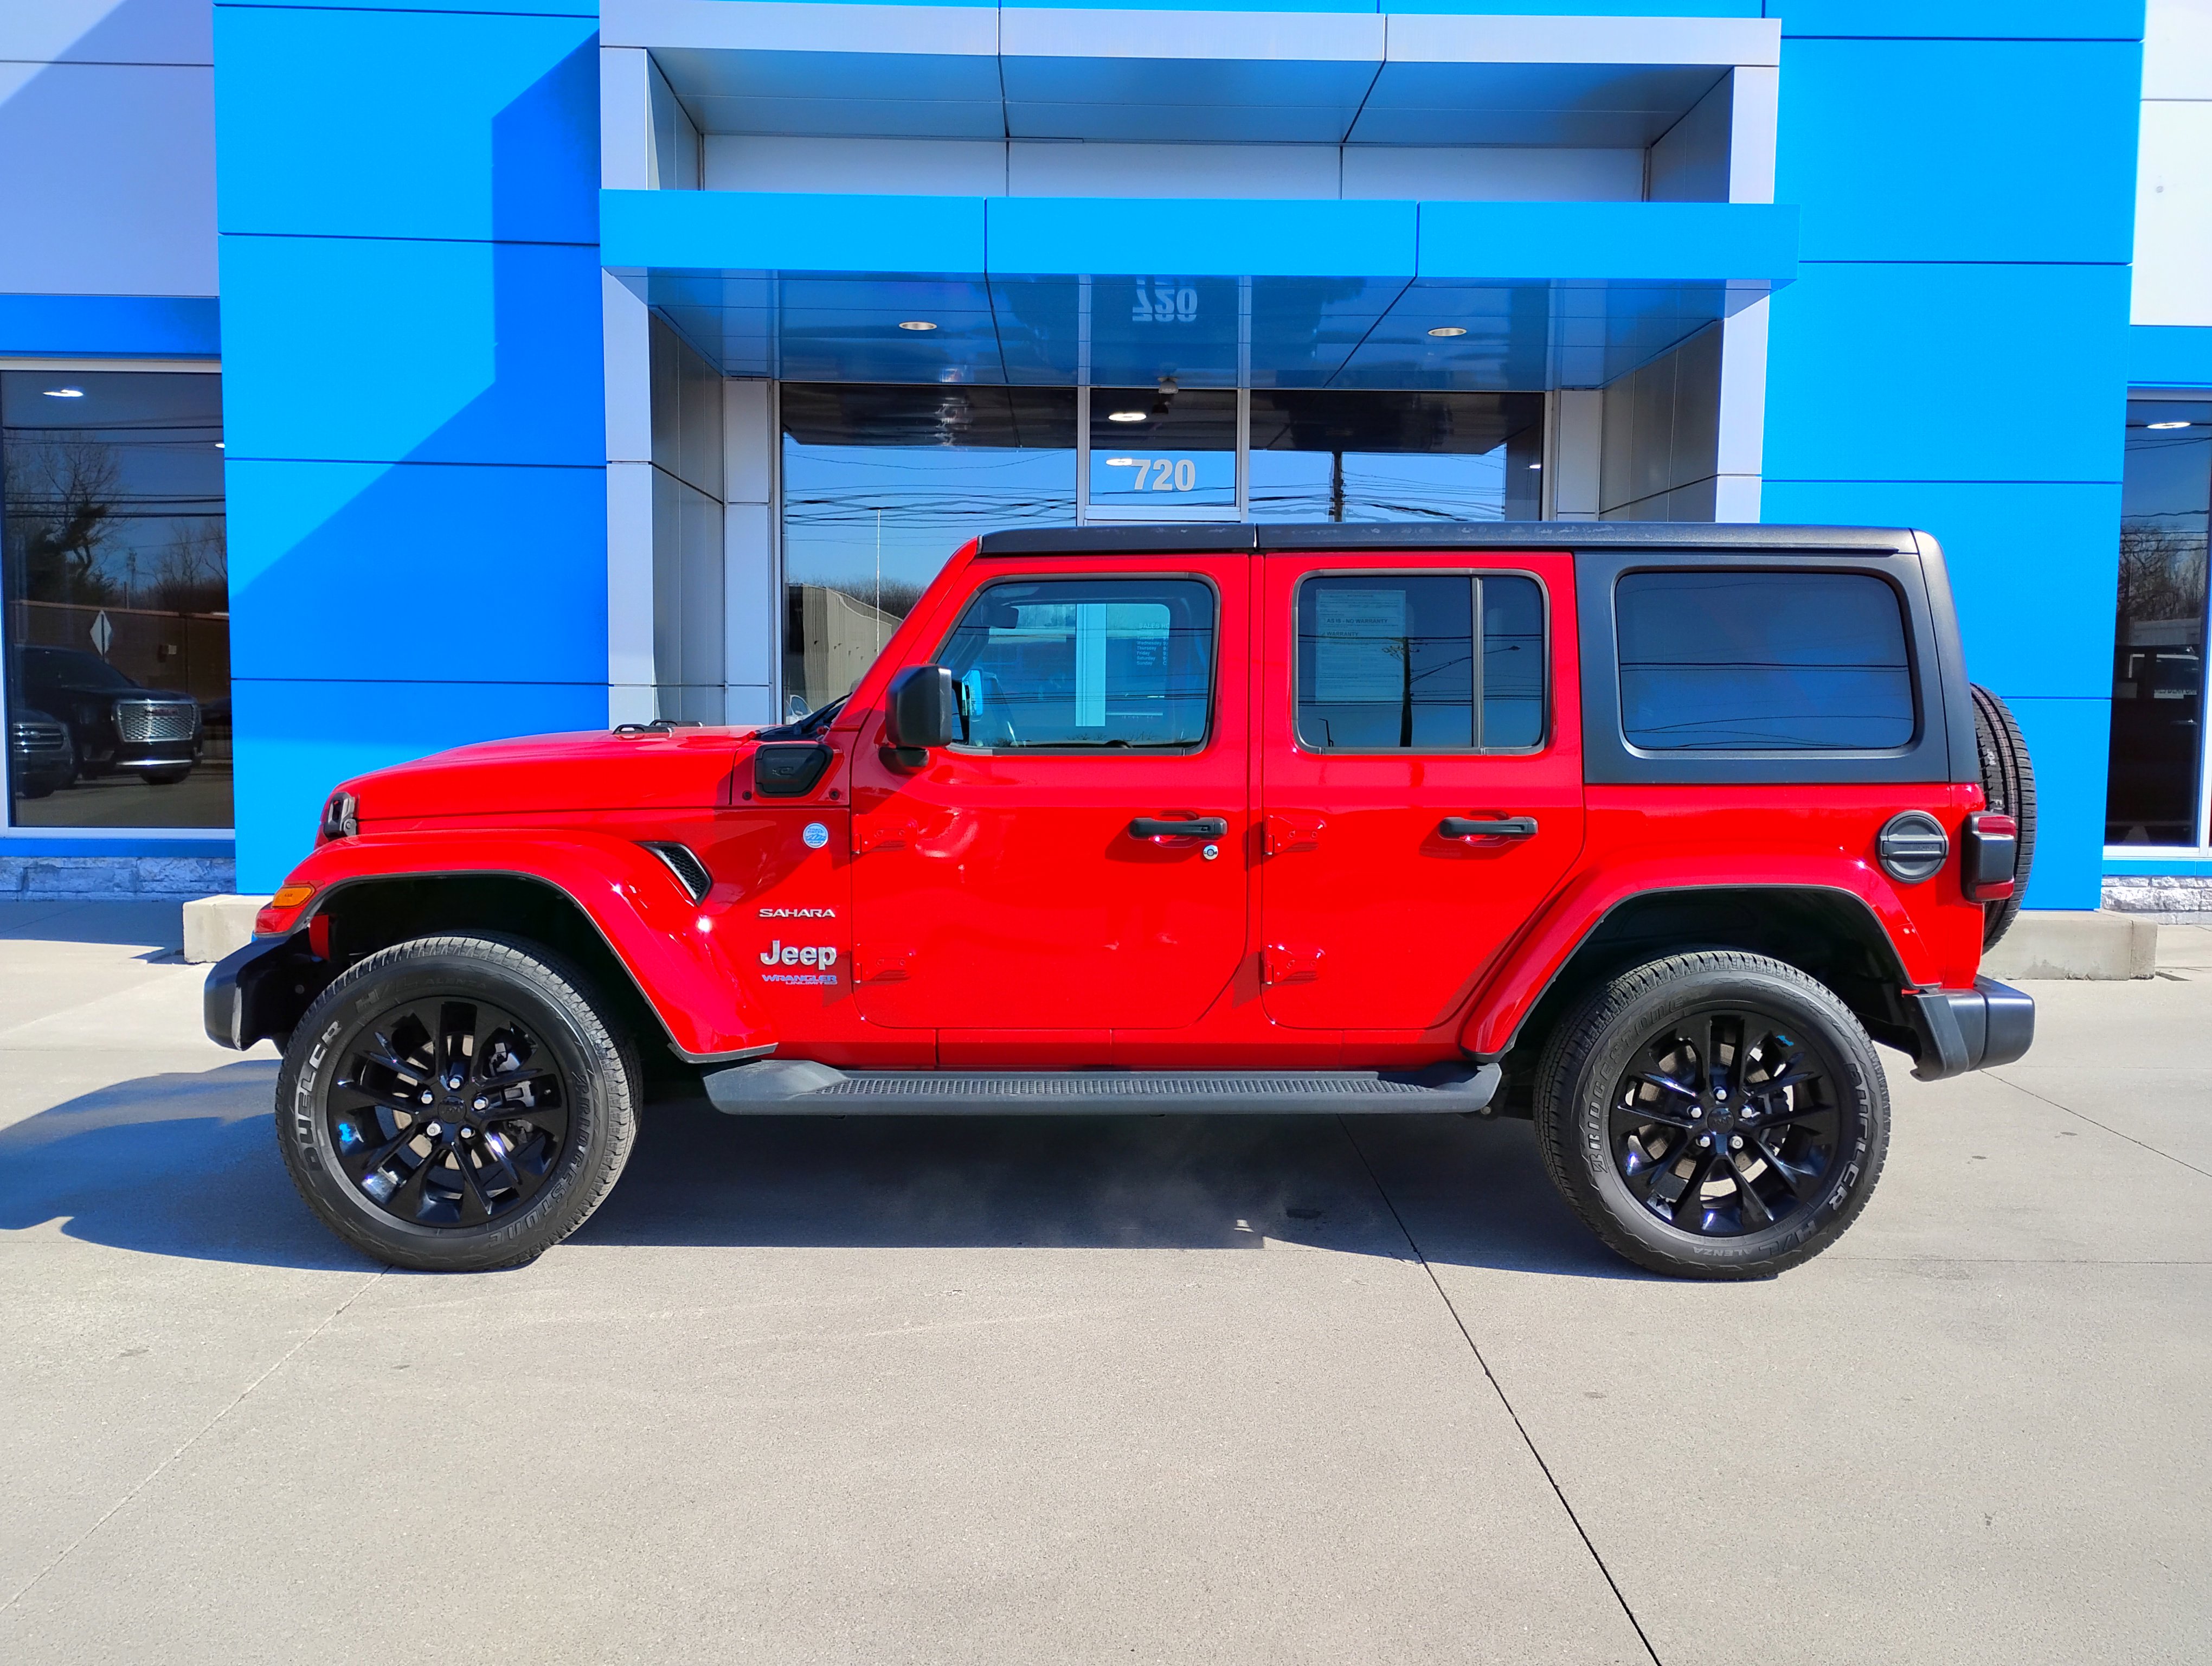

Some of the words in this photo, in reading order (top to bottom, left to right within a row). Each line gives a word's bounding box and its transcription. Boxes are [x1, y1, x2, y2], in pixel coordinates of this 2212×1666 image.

[1129, 459, 1195, 491] 720
[759, 908, 835, 918] SAHARA
[760, 940, 837, 970] Jeep
[297, 1019, 343, 1172] DUELER
[1588, 996, 1683, 1174] BRIDGESTONE
[489, 1072, 591, 1248] BRIDGESTONE
[1828, 1063, 1869, 1211] DUELER
[1693, 1246, 1753, 1257] ALENZA
